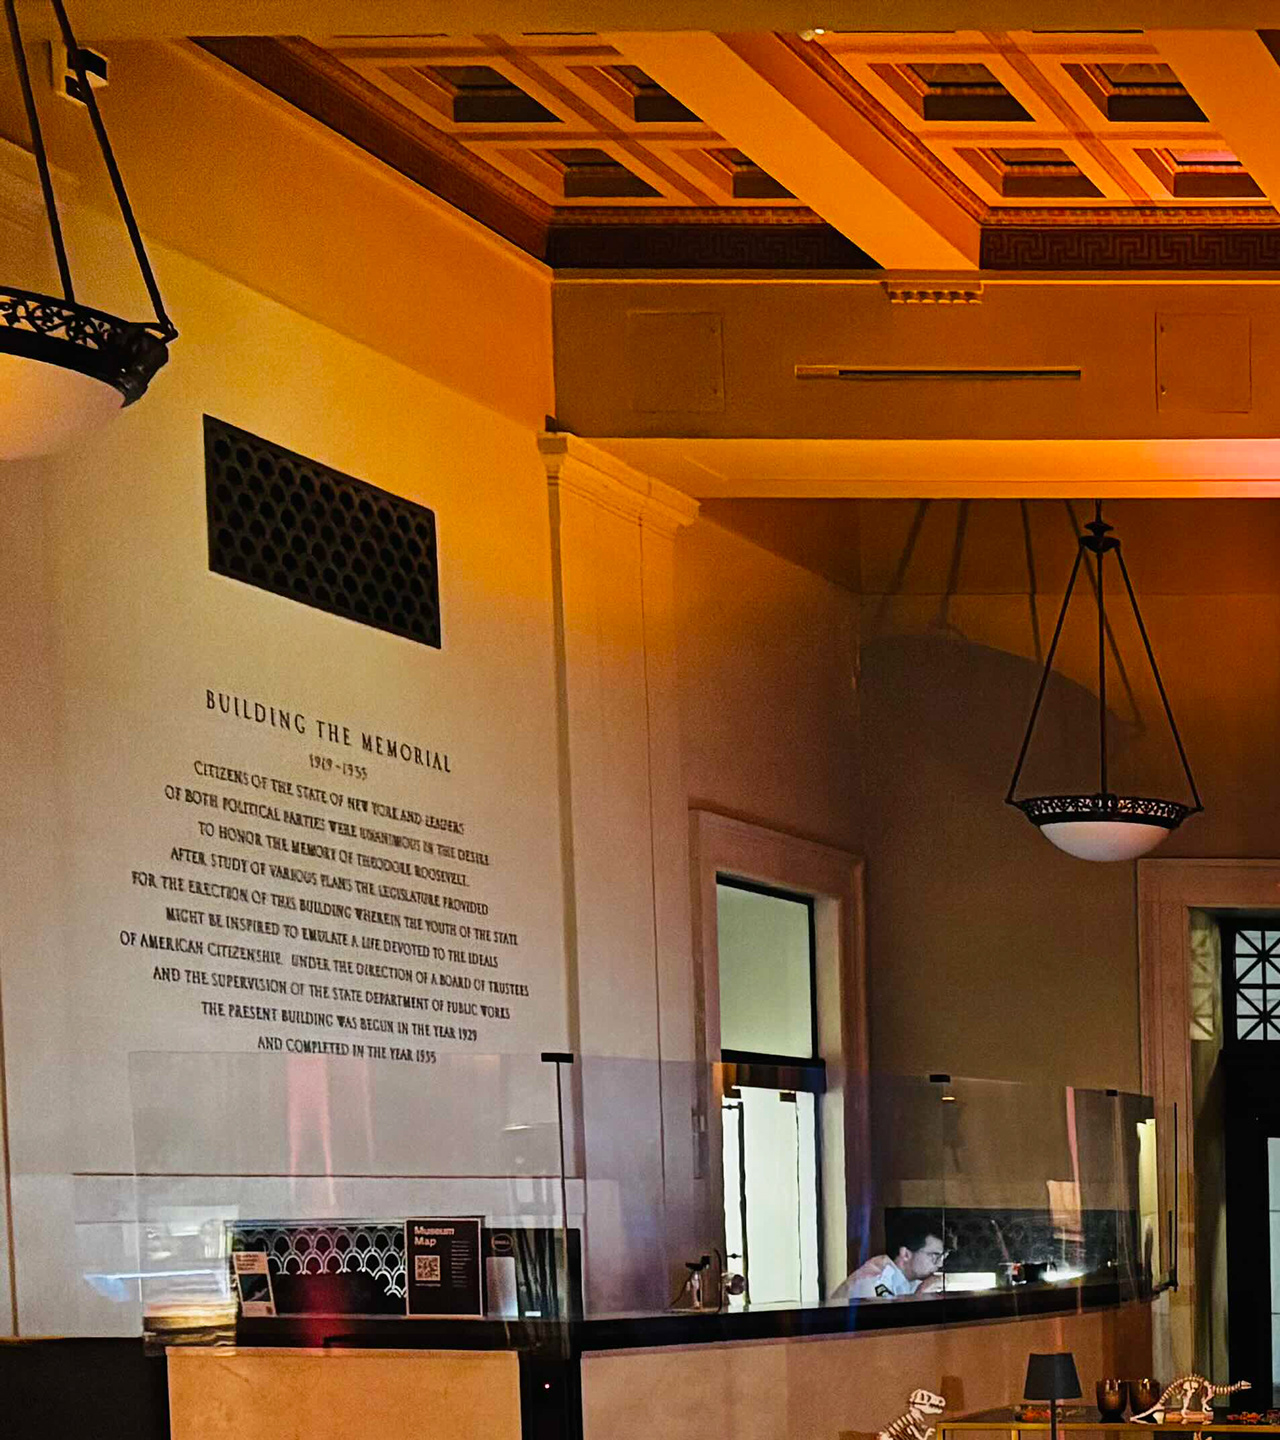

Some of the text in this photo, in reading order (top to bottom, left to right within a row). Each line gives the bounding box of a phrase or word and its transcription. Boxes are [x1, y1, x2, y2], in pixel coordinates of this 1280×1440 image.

[206, 689, 451, 773] BUILDING THE MEMORIAL
[164, 784, 182, 801] OF
[184, 788, 218, 808] BOTH
[222, 796, 281, 822] POLITICAL
[328, 819, 357, 838] WERE
[193, 760, 249, 786] CITIZENS
[251, 774, 268, 790] OF
[270, 778, 292, 796] THE
[296, 784, 327, 804] STATE
[329, 792, 344, 807] OF
[347, 796, 368, 812] NEW
[400, 809, 422, 825] AND
[197, 820, 215, 837] TO
[218, 825, 263, 846] HONOR
[266, 834, 290, 852] THE
[291, 839, 336, 861] MEMORY
[338, 849, 353, 864] OF
[170, 846, 207, 866] AFTER
[210, 853, 248, 873] STUDY
[250, 860, 266, 875] OF
[320, 873, 353, 892] PLANS
[354, 879, 374, 896] THE
[131, 870, 157, 888] FOR
[160, 875, 184, 892] THE
[188, 879, 249, 903] ERECTION
[251, 889, 267, 905] OF
[300, 898, 352, 919] BUILDING
[354, 907, 401, 927] WHEREIN
[403, 915, 423, 930] THE
[424, 919, 456, 936] YOUTH
[459, 925, 471, 938] OF
[474, 927, 491, 942] THE
[493, 930, 518, 946] STATE
[165, 906, 205, 924] MIGHT
[208, 913, 223, 928] BE
[225, 915, 280, 936] INSPIRED
[282, 924, 298, 939] TO
[350, 934, 360, 948] A
[361, 936, 381, 951] LIFE
[383, 939, 430, 958] DEVOTED
[433, 946, 445, 961] TO
[447, 949, 466, 963] THE
[468, 952, 499, 968] IDEALS
[119, 930, 137, 946] OF
[140, 933, 204, 955] AMERICAN
[291, 953, 331, 971] UNDER
[333, 959, 354, 974] THE
[356, 962, 413, 982] DIRECTION
[415, 970, 428, 984] OF
[431, 973, 438, 985] A
[439, 973, 471, 989] BOARD
[473, 978, 485, 991] OF
[488, 980, 529, 997] TRUSTEES
[153, 966, 180, 982] AND
[184, 969, 208, 985] THE
[211, 972, 287, 994] SUPERVISION
[290, 981, 304, 996] OF
[308, 984, 330, 999] THE
[332, 986, 363, 1003] STATE
[365, 990, 429, 1010] DEPARTMENT
[431, 998, 444, 1012] OF
[446, 1000, 478, 1016] PUBLIC
[201, 1001, 478, 1042] THE PRESENT BUILDING WAS BEGUN IN THE YEAR 1929
[257, 1036, 437, 1064] AND COMPLETED IN THE YEAR 1935
[414, 1226, 455, 1236] Museum
[414, 1236, 437, 1248] Map
